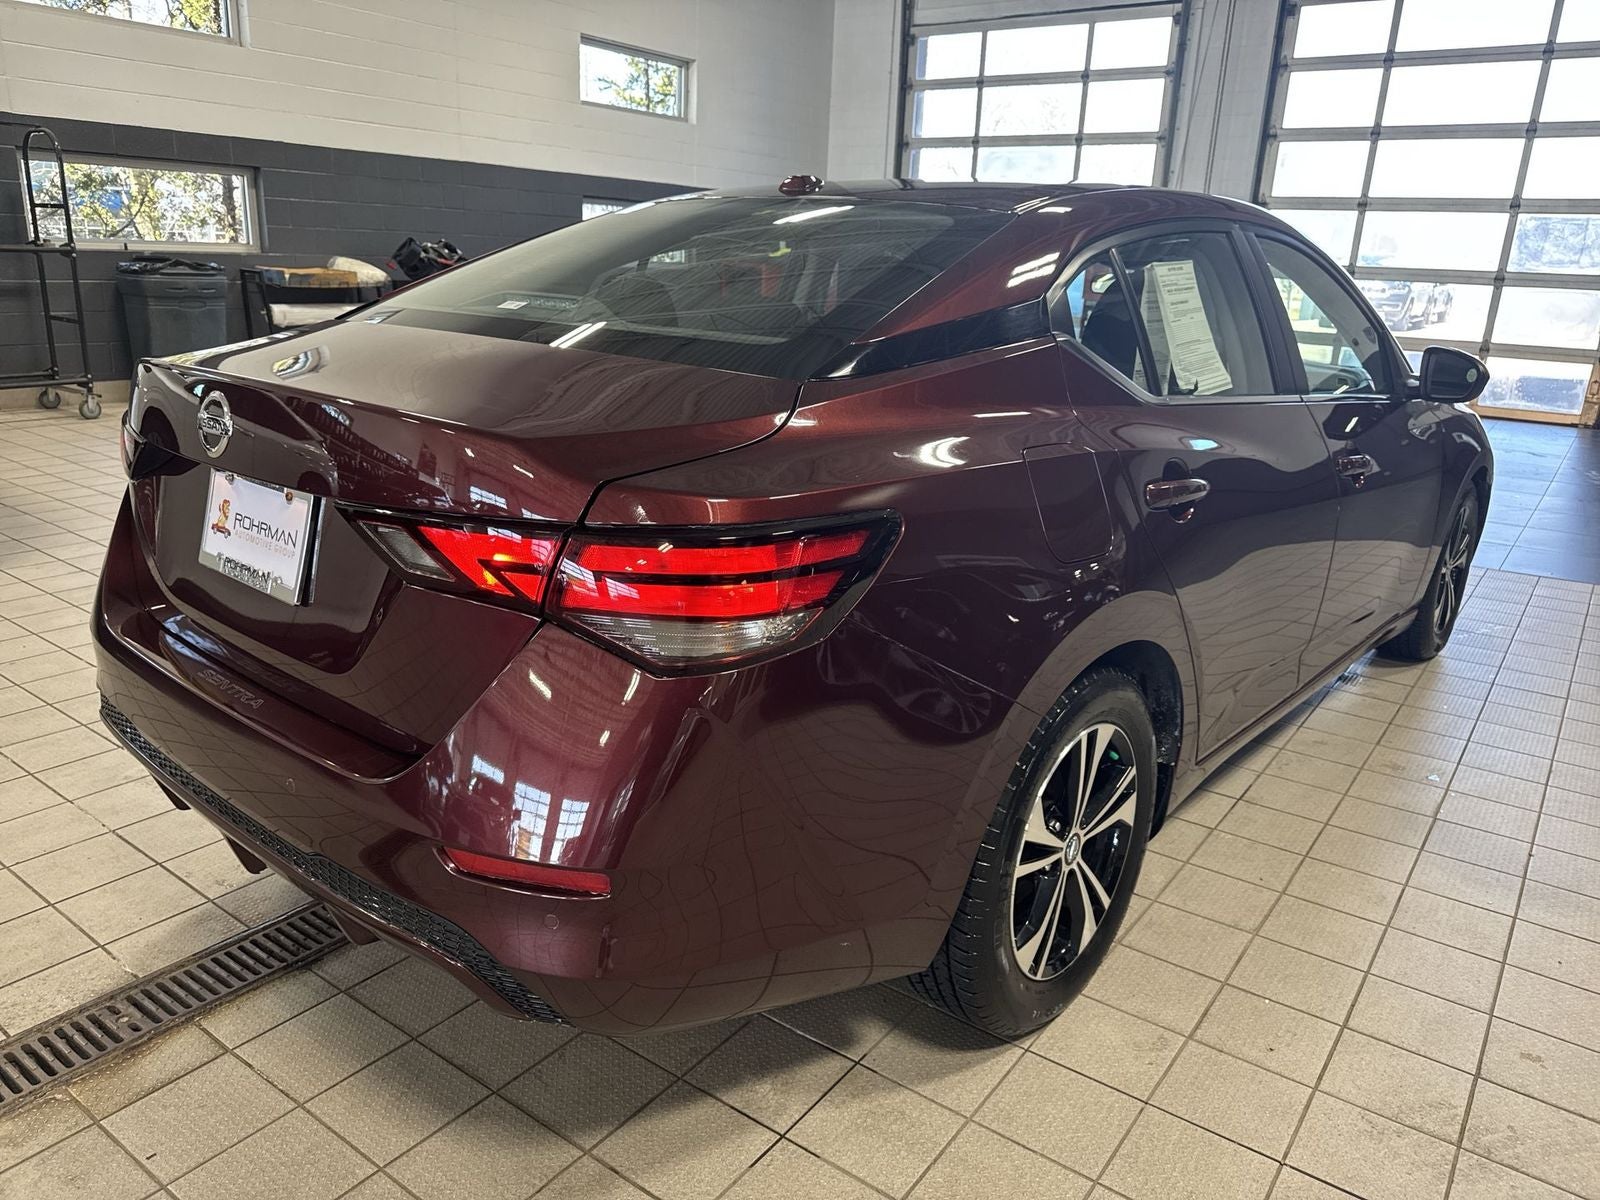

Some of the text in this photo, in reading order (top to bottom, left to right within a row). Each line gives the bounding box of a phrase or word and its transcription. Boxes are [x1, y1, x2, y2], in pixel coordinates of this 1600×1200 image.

[200, 415, 230, 435] SSAN
[233, 512, 298, 549] ROHRMAN
[224, 556, 271, 584] ROHRMAN
